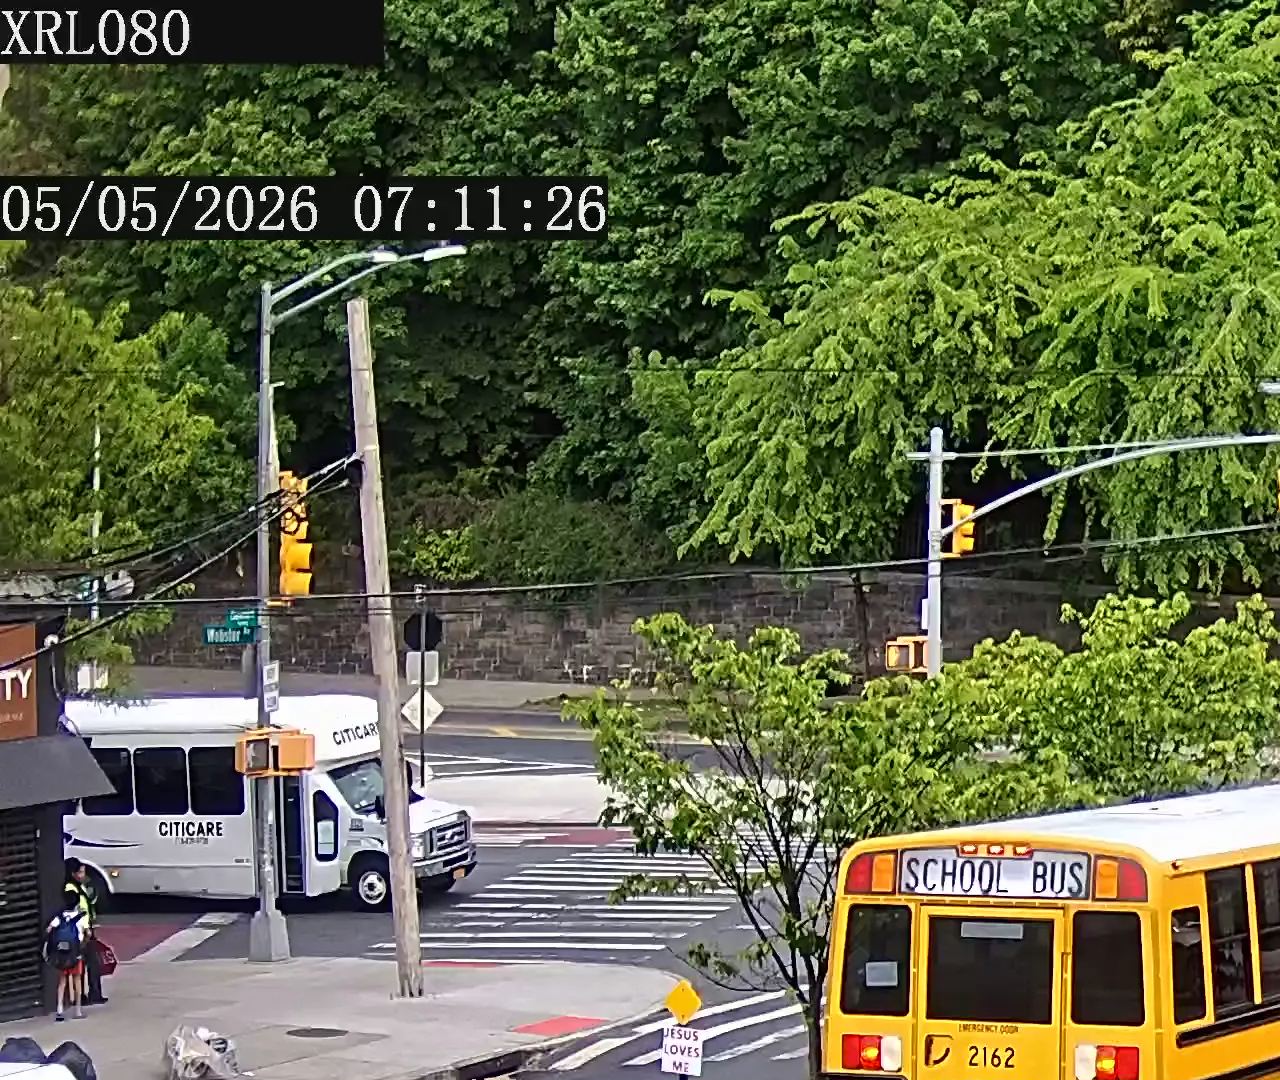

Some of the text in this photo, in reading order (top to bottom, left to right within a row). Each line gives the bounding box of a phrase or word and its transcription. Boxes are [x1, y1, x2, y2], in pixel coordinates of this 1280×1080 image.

[158, 821, 225, 837] CITICARE
[905, 857, 1084, 896] SCHOOL BUS
[664, 1028, 699, 1041] JESUS
[664, 1044, 700, 1058] LOVES
[968, 1045, 1015, 1069] 2162
[672, 1061, 689, 1073] ME
